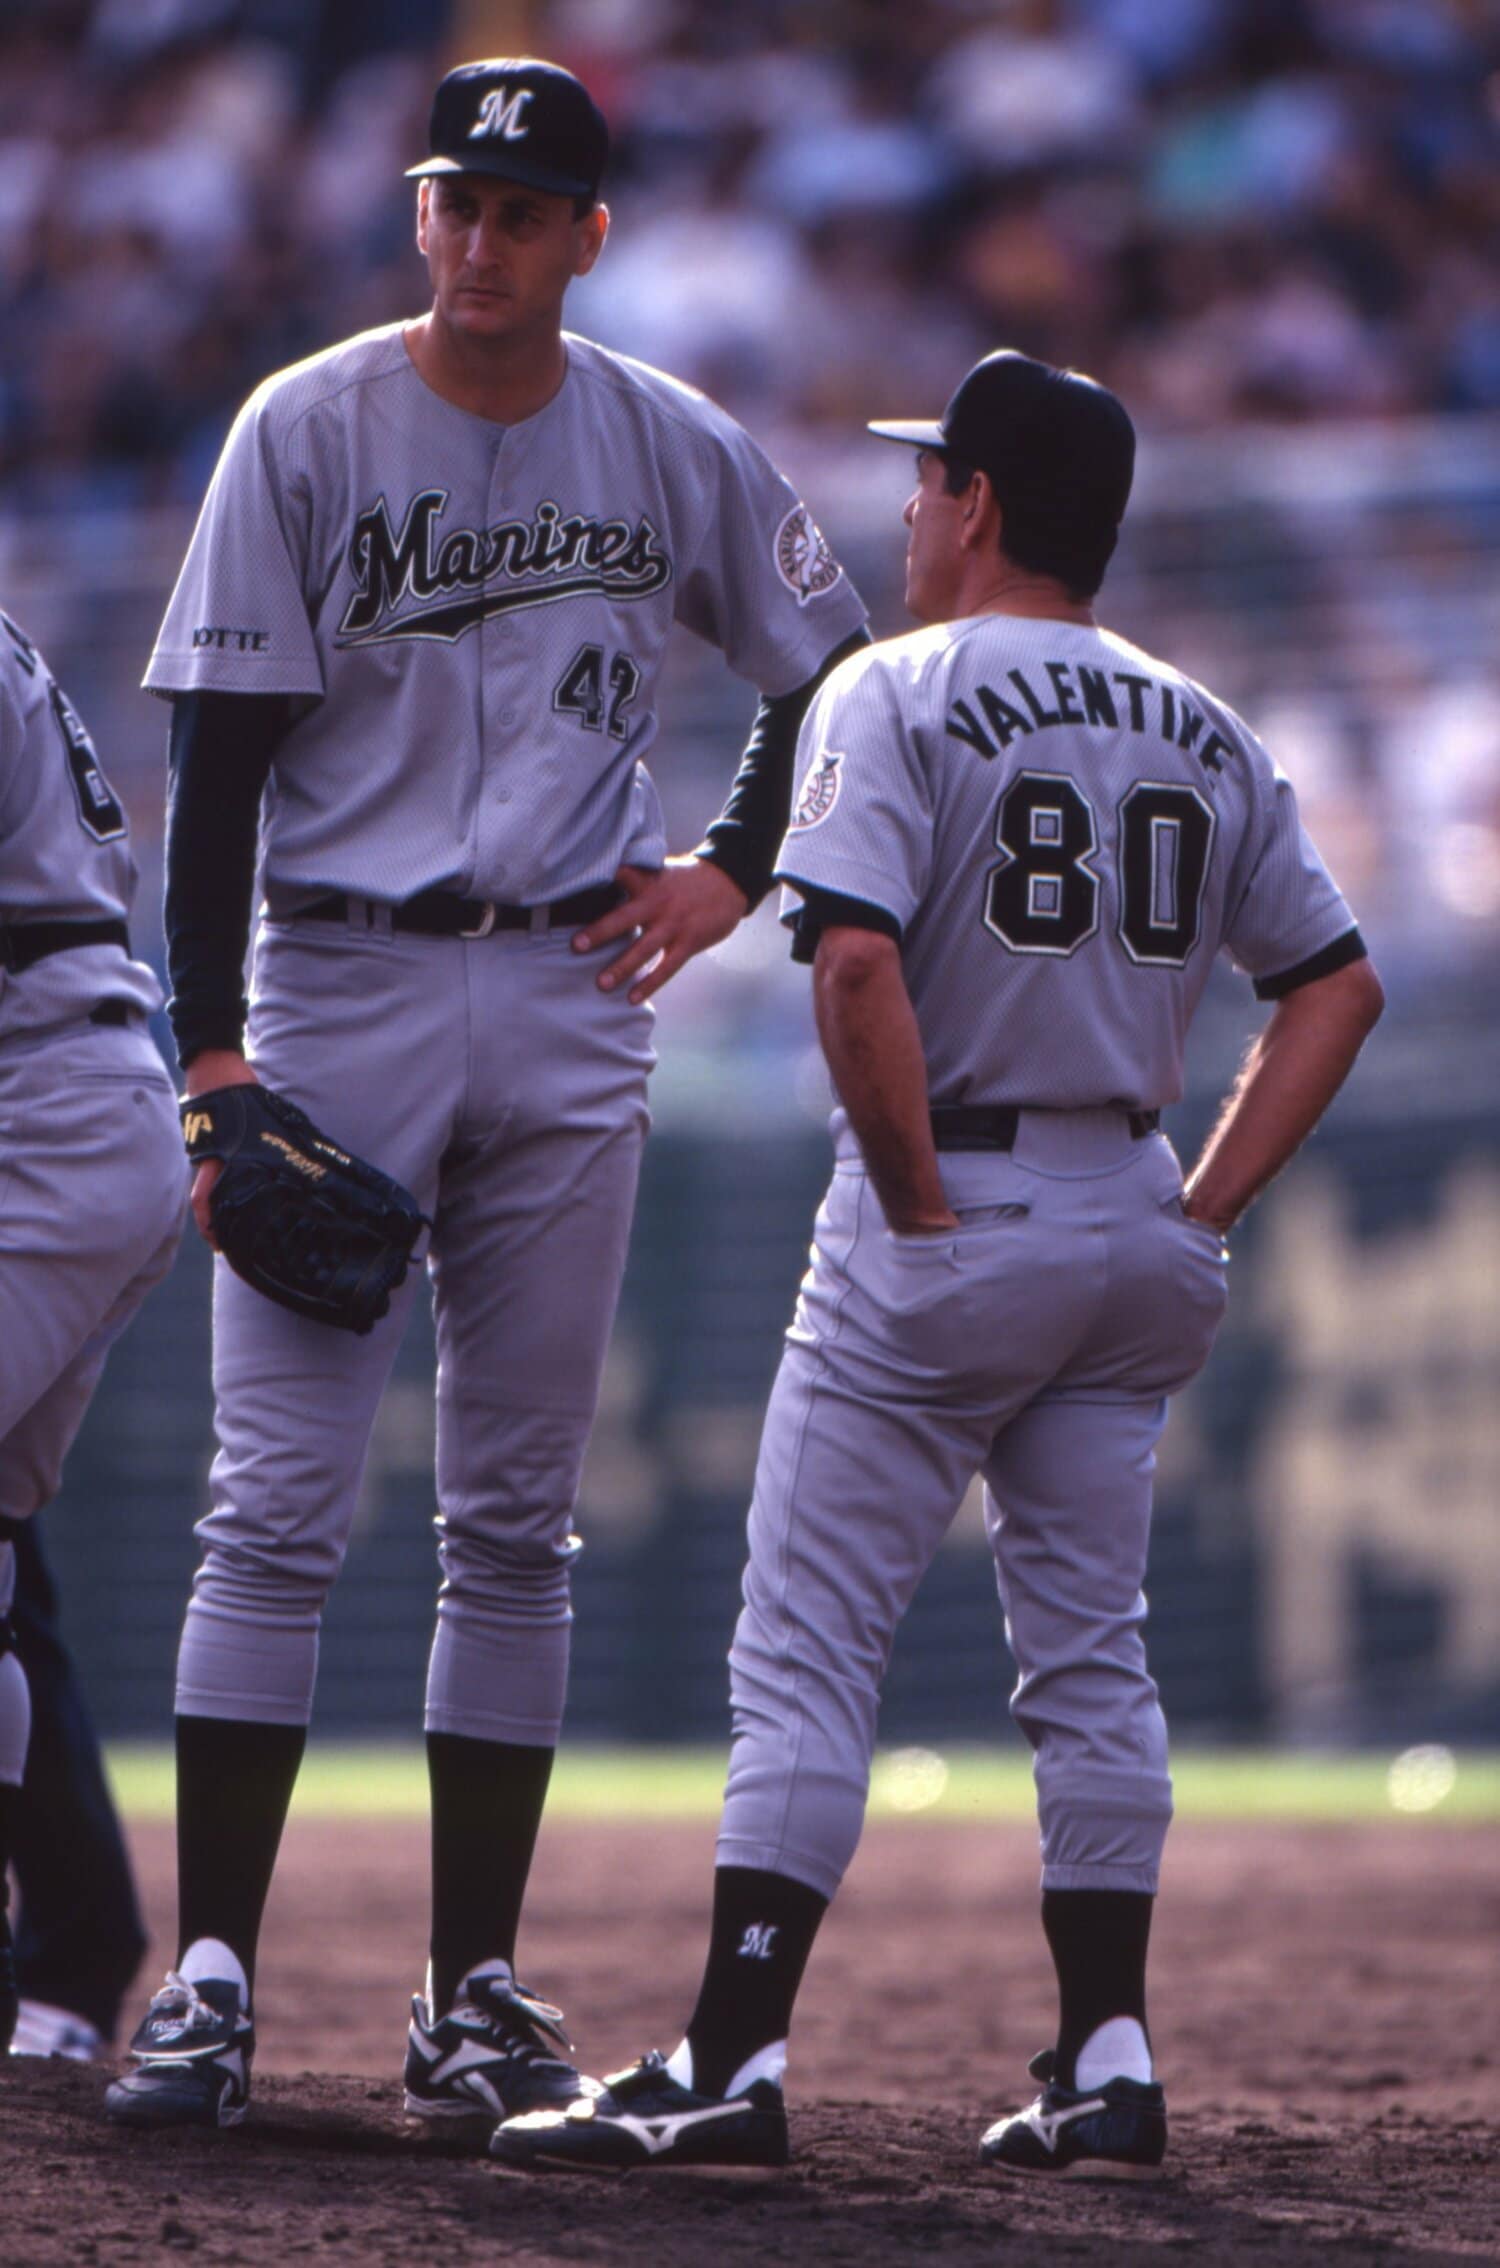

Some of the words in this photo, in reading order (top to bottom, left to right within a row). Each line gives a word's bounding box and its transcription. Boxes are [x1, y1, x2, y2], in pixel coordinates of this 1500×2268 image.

[468, 84, 535, 141] M
[335, 488, 672, 649] Marines
[551, 642, 641, 742] 42
[982, 768, 1217, 970] 80
